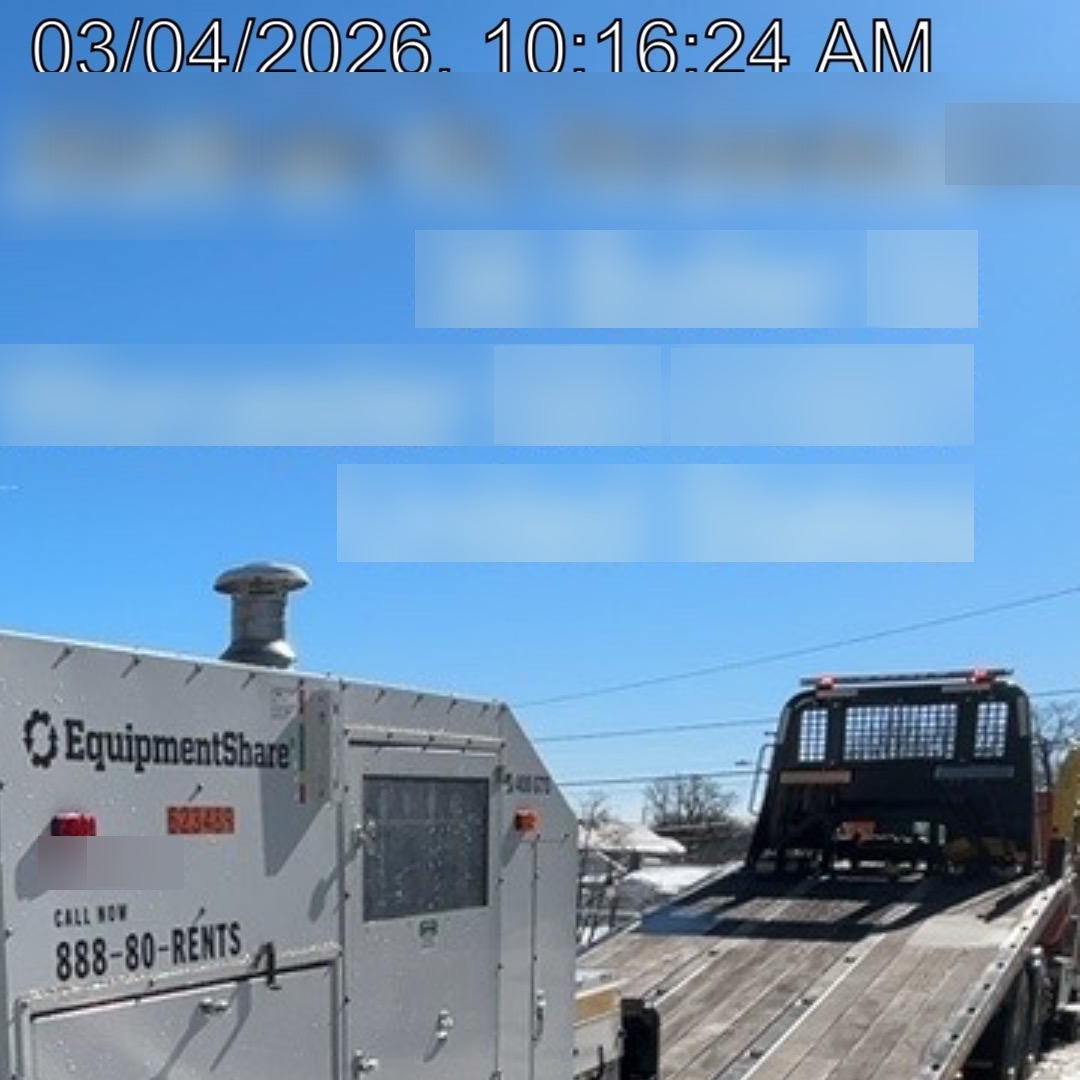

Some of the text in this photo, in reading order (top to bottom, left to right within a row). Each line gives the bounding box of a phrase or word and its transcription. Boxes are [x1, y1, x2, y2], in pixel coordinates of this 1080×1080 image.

[64, 717, 290, 773] EquipmentShare
[54, 904, 127, 928] CALL NOW
[56, 921, 242, 982] 888-80-RENTS
